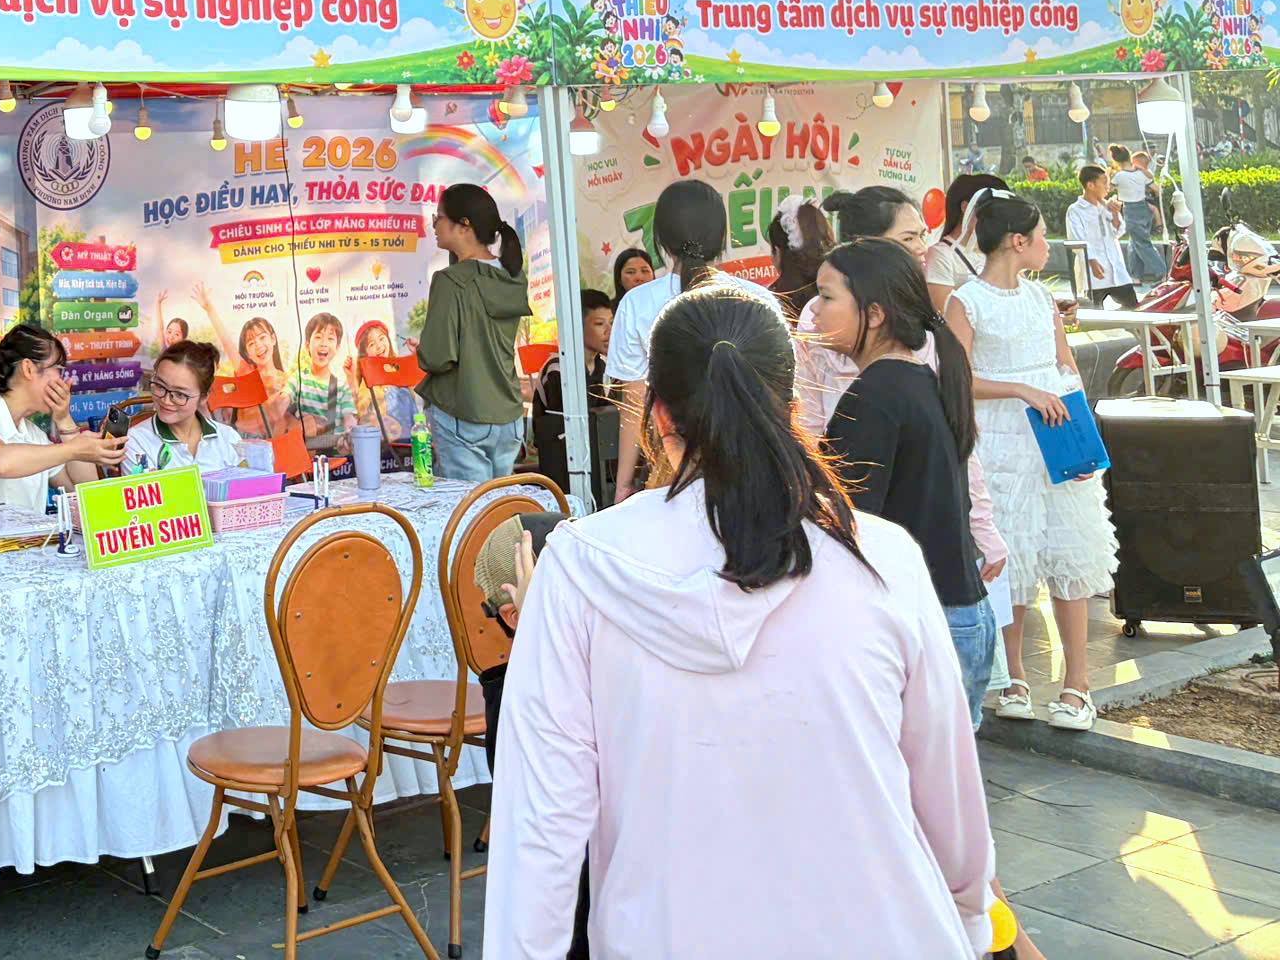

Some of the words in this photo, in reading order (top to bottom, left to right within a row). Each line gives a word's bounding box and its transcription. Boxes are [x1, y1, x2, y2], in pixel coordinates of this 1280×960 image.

[886, 6, 914, 36] vụ
[919, 2, 948, 36] sự
[623, 43, 667, 66] 2026
[1223, 37, 1252, 56] 2026
[22, 139, 31, 173] TRUNG
[39, 107, 59, 121] DỊCH
[671, 111, 776, 177] NGÀY
[785, 112, 840, 171] HỘI
[301, 136, 398, 171] 2026
[895, 149, 912, 159] DUY
[588, 161, 604, 172] HỌC
[604, 158, 618, 169] VUI
[603, 170, 623, 184] NGÀY
[904, 174, 916, 184] LAI
[63, 197, 80, 206] NAM
[143, 196, 190, 225] HỌC
[194, 181, 247, 215] ĐIỀU
[250, 182, 299, 208] HAY,
[305, 174, 361, 202] THỎA
[365, 175, 406, 202] SỨC
[219, 226, 252, 240] CHIÊU
[255, 224, 283, 236] SINH
[285, 219, 308, 232] CÁC
[309, 217, 330, 231] LỚP
[334, 217, 366, 230] NĂNG
[368, 215, 400, 229] KHIẾU
[233, 245, 262, 258] DÀNH
[264, 242, 285, 253] CHO
[287, 236, 316, 251] THIẾU
[318, 239, 336, 249] NHI
[337, 237, 352, 248] TỪ
[353, 239, 360, 247] 5
[370, 238, 380, 247] 15
[382, 234, 405, 247] TUỔI
[299, 287, 314, 296] GIÁO
[61, 311, 80, 320] Đàn
[83, 310, 113, 321] Organ
[232, 303, 245, 311] HỌC
[258, 301, 268, 309] VUI
[115, 367, 134, 379] SỐNG
[123, 481, 163, 511] BAN
[95, 515, 155, 556] TUYỂN
[158, 513, 202, 544] SINH
